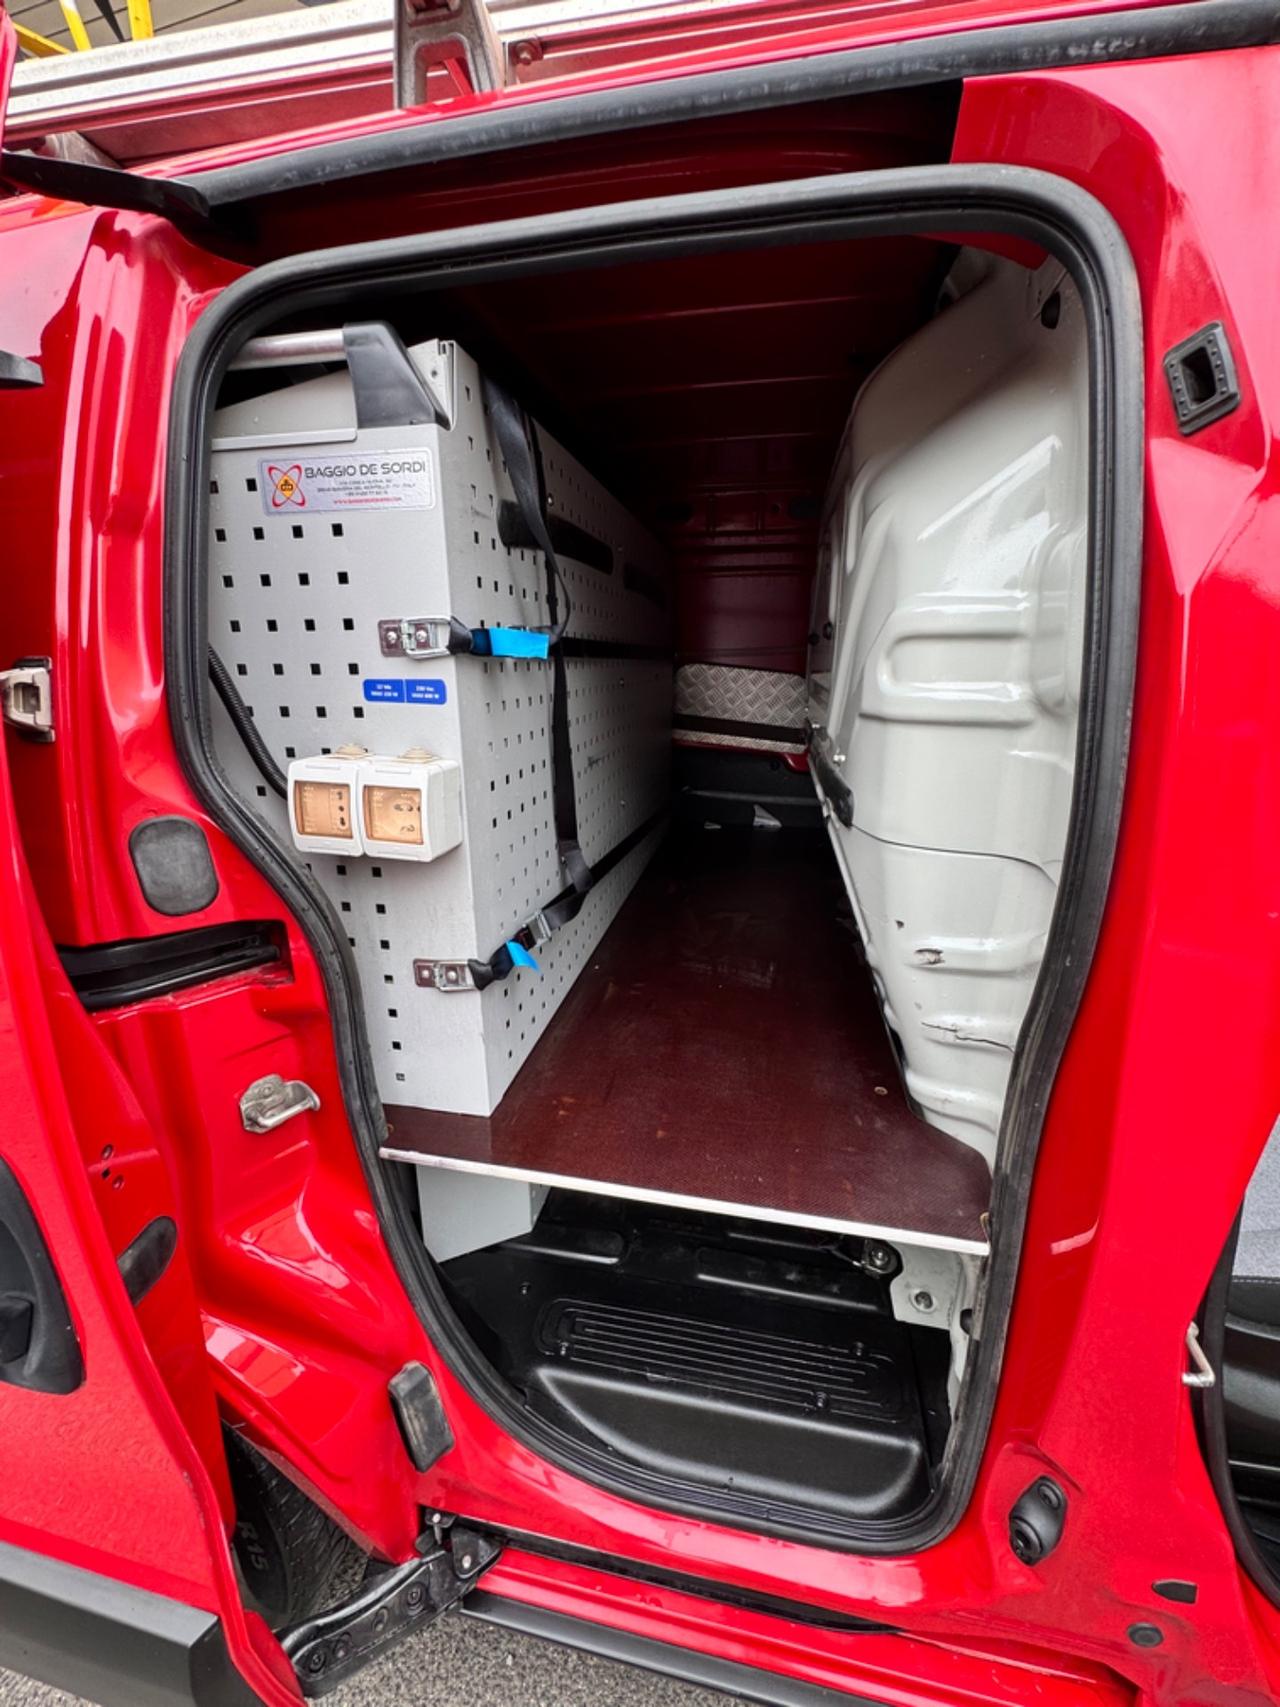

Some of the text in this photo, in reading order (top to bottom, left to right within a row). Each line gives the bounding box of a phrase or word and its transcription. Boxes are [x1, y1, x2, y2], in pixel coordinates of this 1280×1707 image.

[305, 462, 425, 478] BAGGIO DE SORDI
